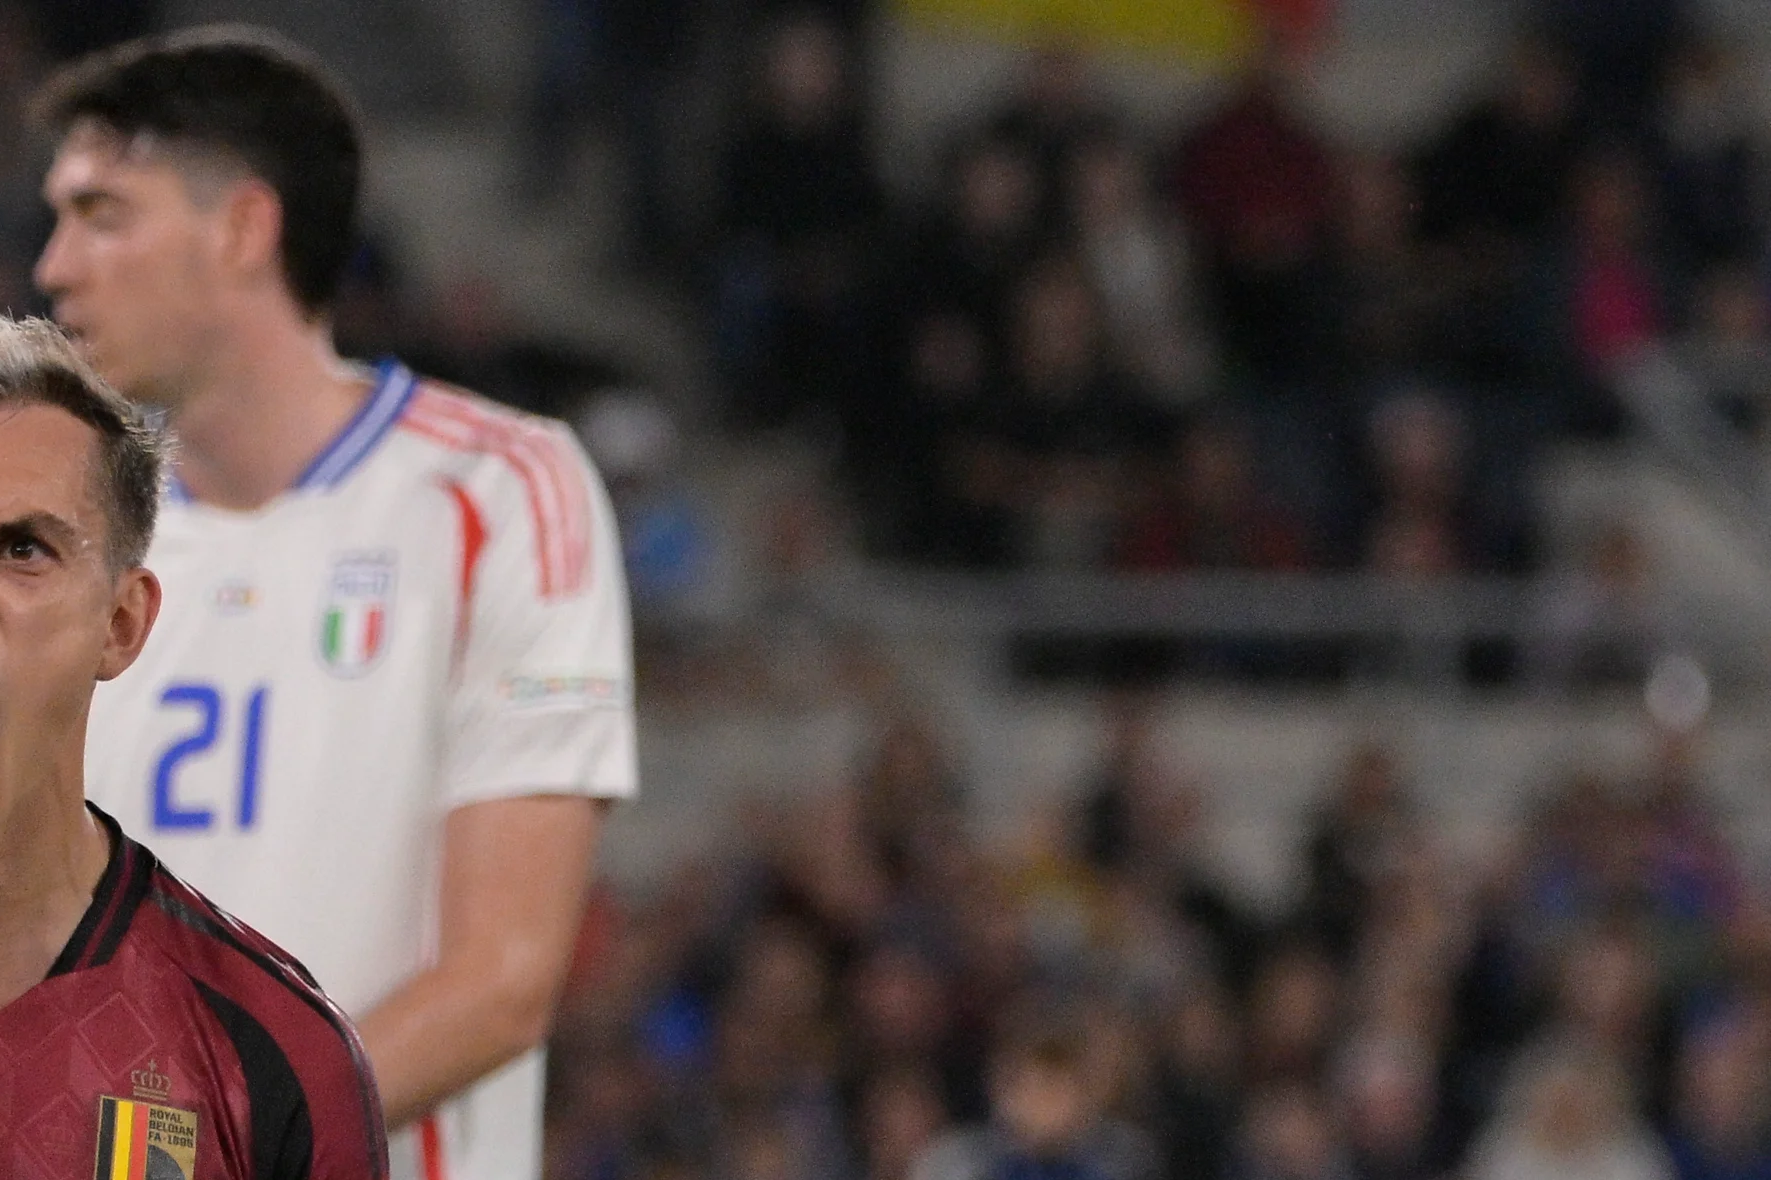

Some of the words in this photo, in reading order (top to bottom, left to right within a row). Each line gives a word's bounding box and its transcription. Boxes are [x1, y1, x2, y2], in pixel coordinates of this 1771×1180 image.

[153, 681, 268, 833] 21
[149, 1108, 183, 1124] ROYAL
[148, 1120, 194, 1137] BELGIAN
